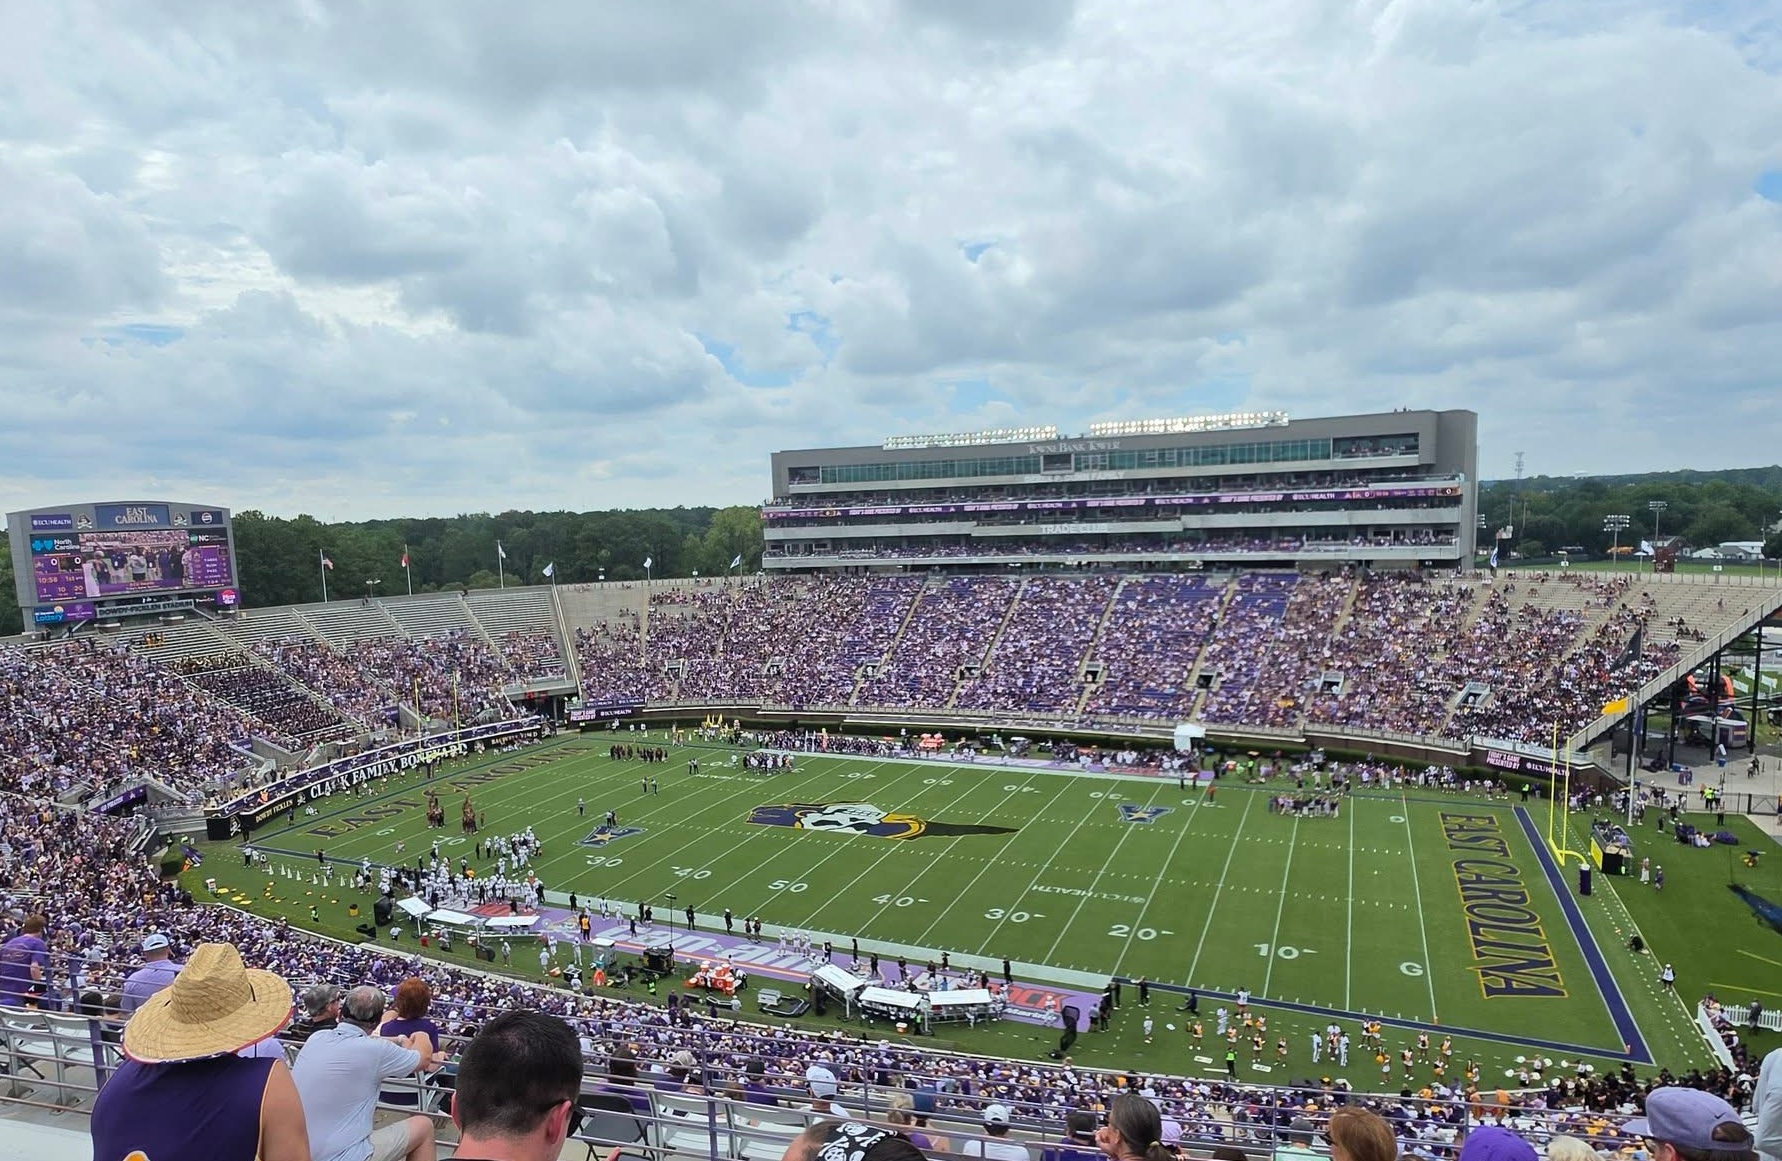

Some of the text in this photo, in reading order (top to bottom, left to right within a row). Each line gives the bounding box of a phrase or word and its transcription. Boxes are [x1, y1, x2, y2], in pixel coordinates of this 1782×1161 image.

[1060, 443, 1086, 452] BANK
[115, 513, 158, 524] CAROLINA
[126, 507, 147, 515] EAST
[1041, 524, 1078, 535] TRADE
[51, 558, 58, 566] 0
[305, 798, 423, 839] EAST
[1438, 811, 1512, 859] EAST
[586, 854, 623, 868] 30
[676, 865, 712, 881] 40
[767, 879, 808, 894] 50
[872, 893, 915, 908] 40
[984, 908, 1030, 923] 30
[1107, 924, 1158, 941] 20
[1452, 859, 1569, 1000] CAROLINA
[1253, 943, 1299, 960] 10
[1400, 961, 1424, 977] G
